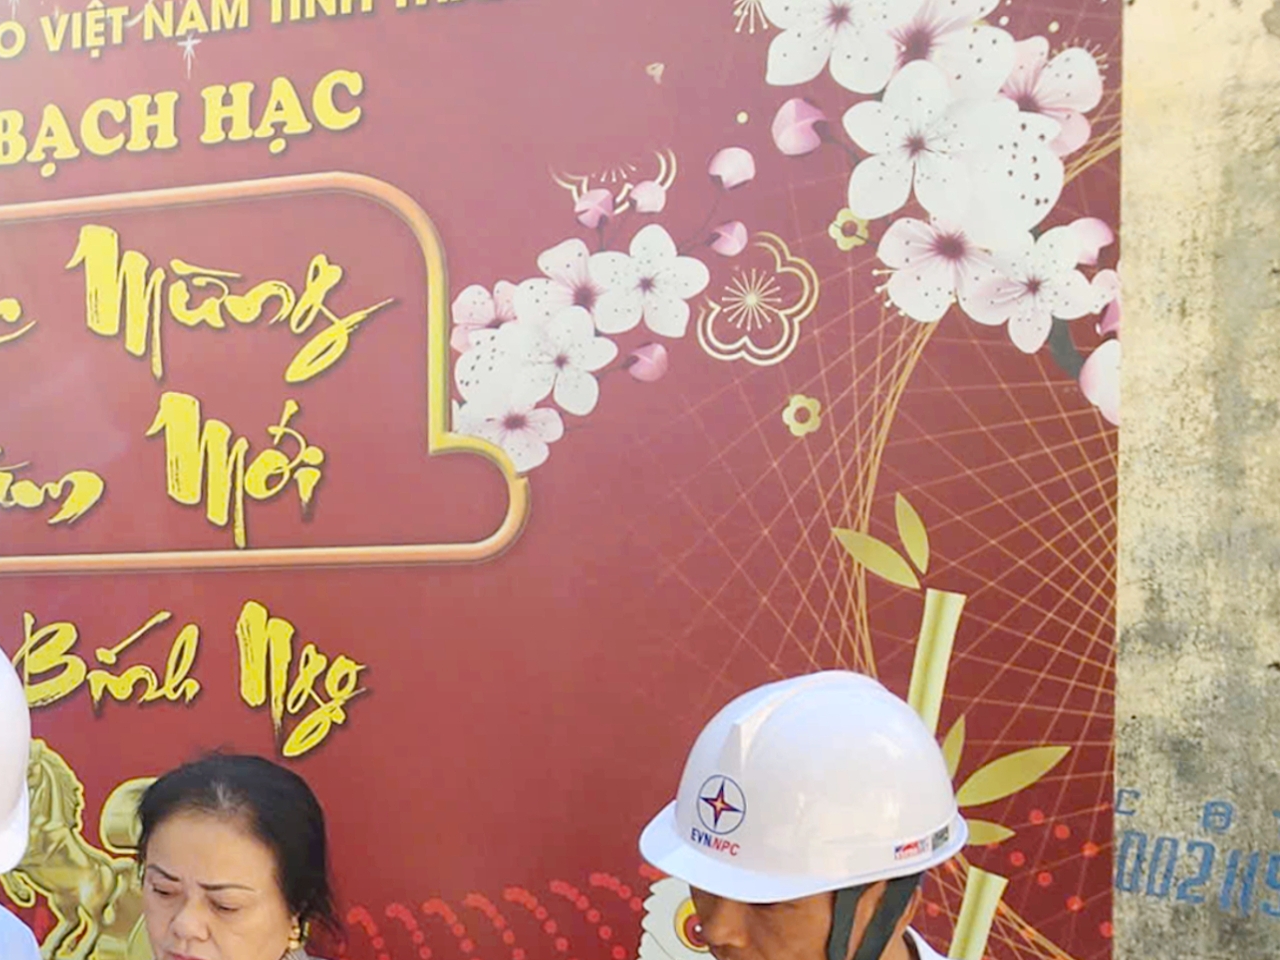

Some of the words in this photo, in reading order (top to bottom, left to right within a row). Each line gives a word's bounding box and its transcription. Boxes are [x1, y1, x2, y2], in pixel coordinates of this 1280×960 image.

[40, 0, 130, 58] VIỆT
[143, 0, 249, 41] NAM
[199, 69, 364, 154] HẠC
[145, 391, 325, 549] Mới
[11, 610, 201, 710] Bính
